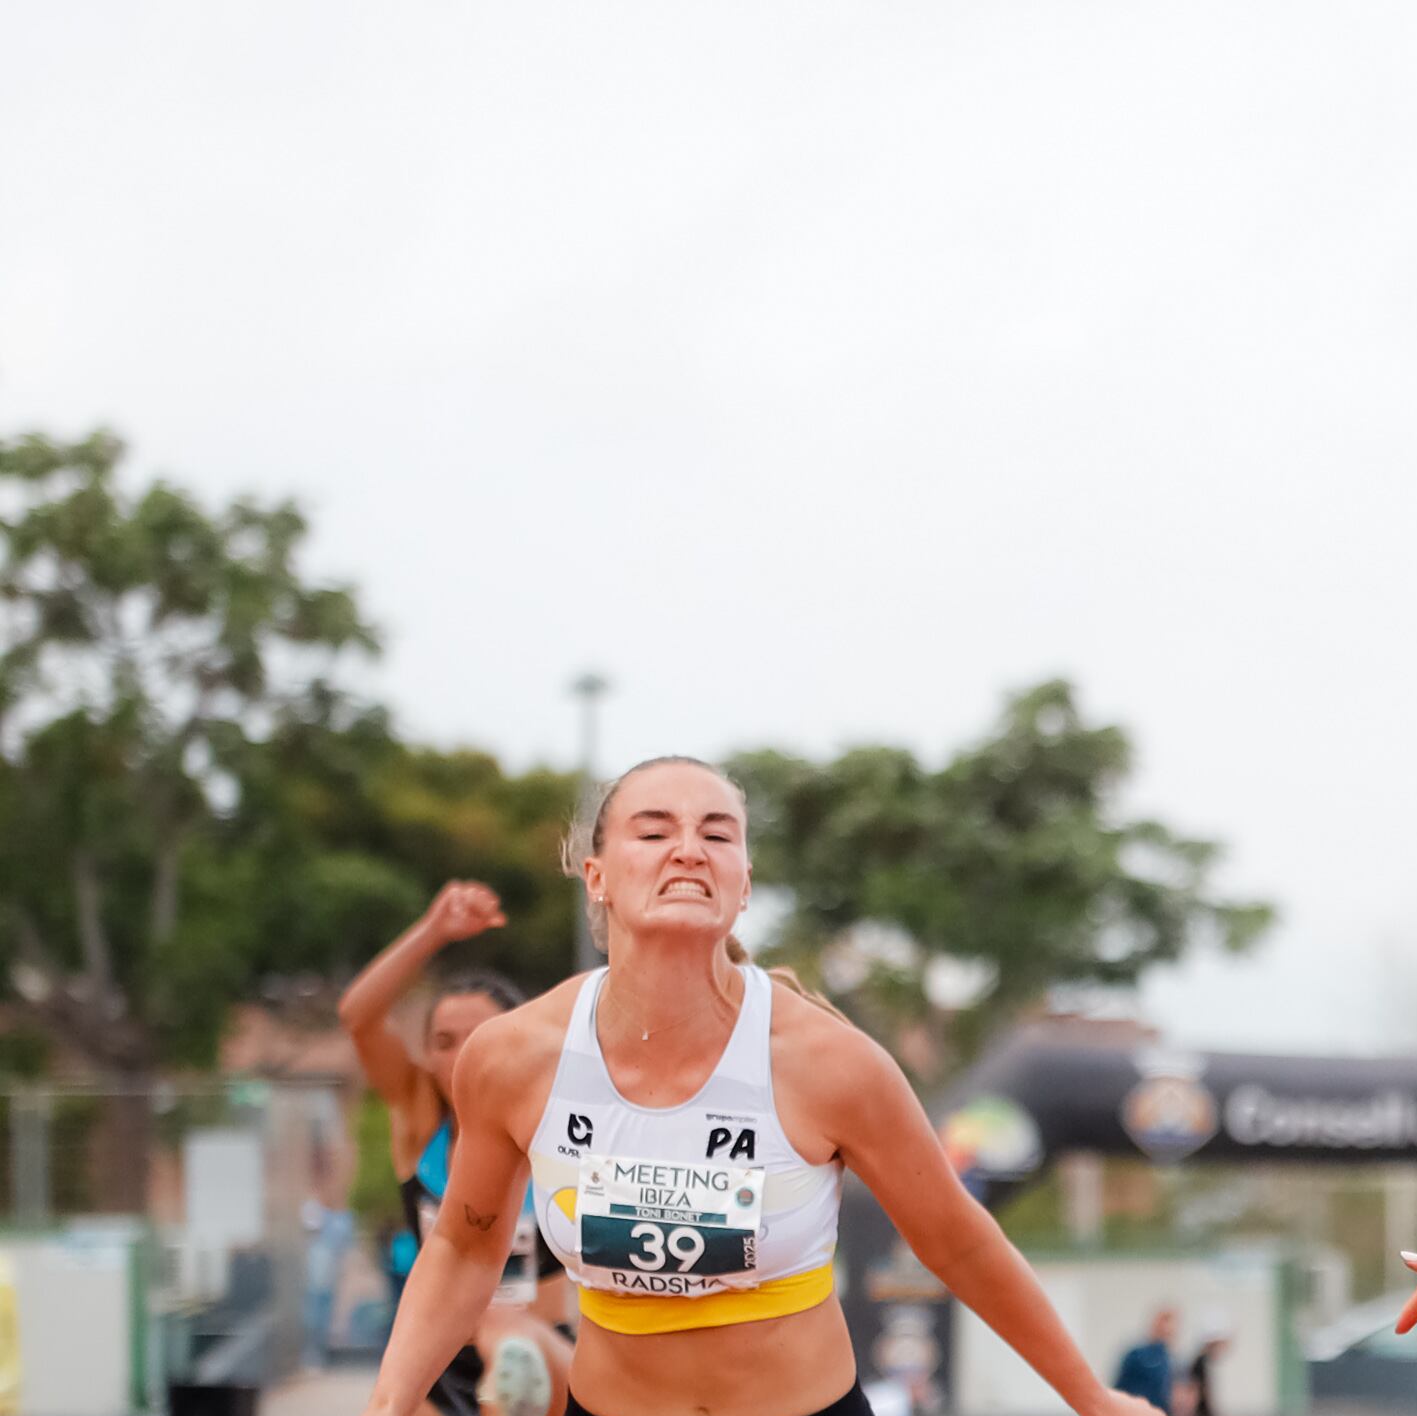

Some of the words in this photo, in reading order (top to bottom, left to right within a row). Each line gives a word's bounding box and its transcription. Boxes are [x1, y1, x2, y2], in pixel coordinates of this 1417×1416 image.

[705, 1127, 756, 1161] PA
[614, 1163, 728, 1191] MEETING
[639, 1187, 692, 1209] IBIZA
[635, 1206, 661, 1219] TONI
[664, 1210, 703, 1223] BONET
[629, 1223, 705, 1272] 39
